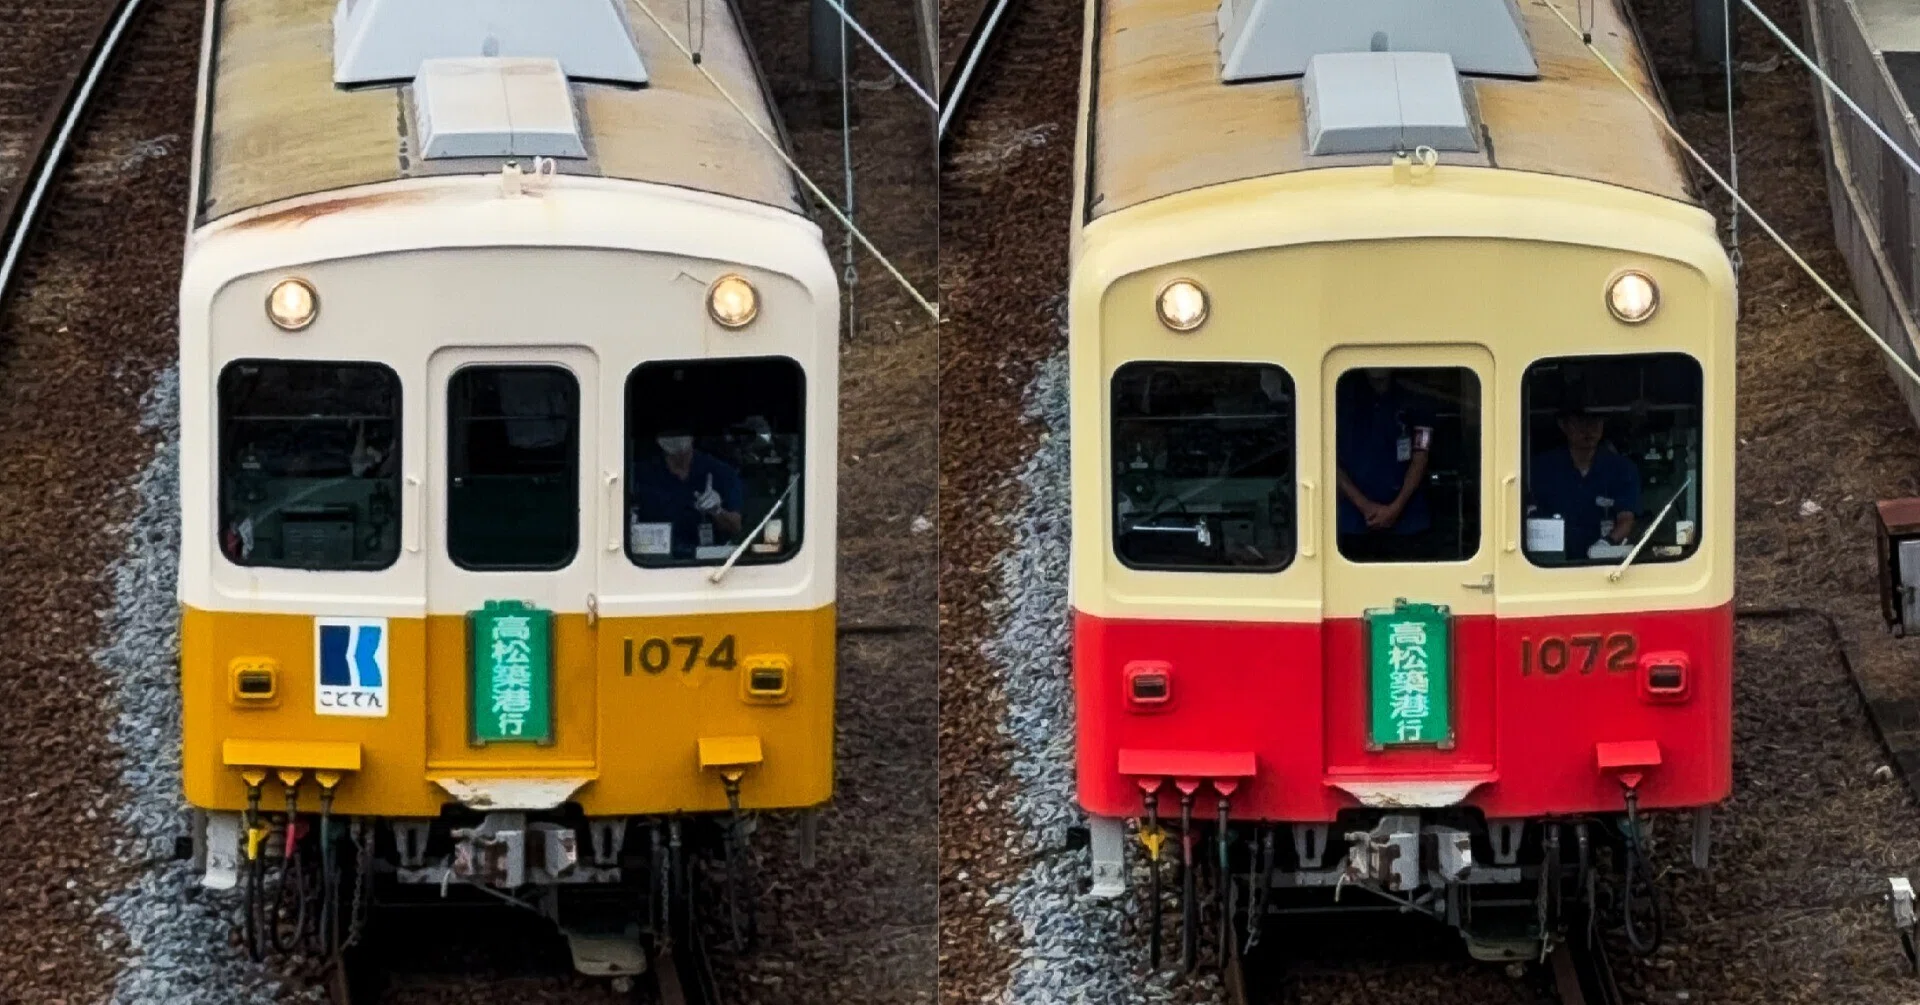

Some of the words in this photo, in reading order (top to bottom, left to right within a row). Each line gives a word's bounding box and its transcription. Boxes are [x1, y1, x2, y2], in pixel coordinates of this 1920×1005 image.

[491, 615, 531, 736] 高松築港行
[623, 634, 738, 677] 1074
[1388, 621, 1429, 742] 高松築港行
[1521, 631, 1638, 677] 1072
